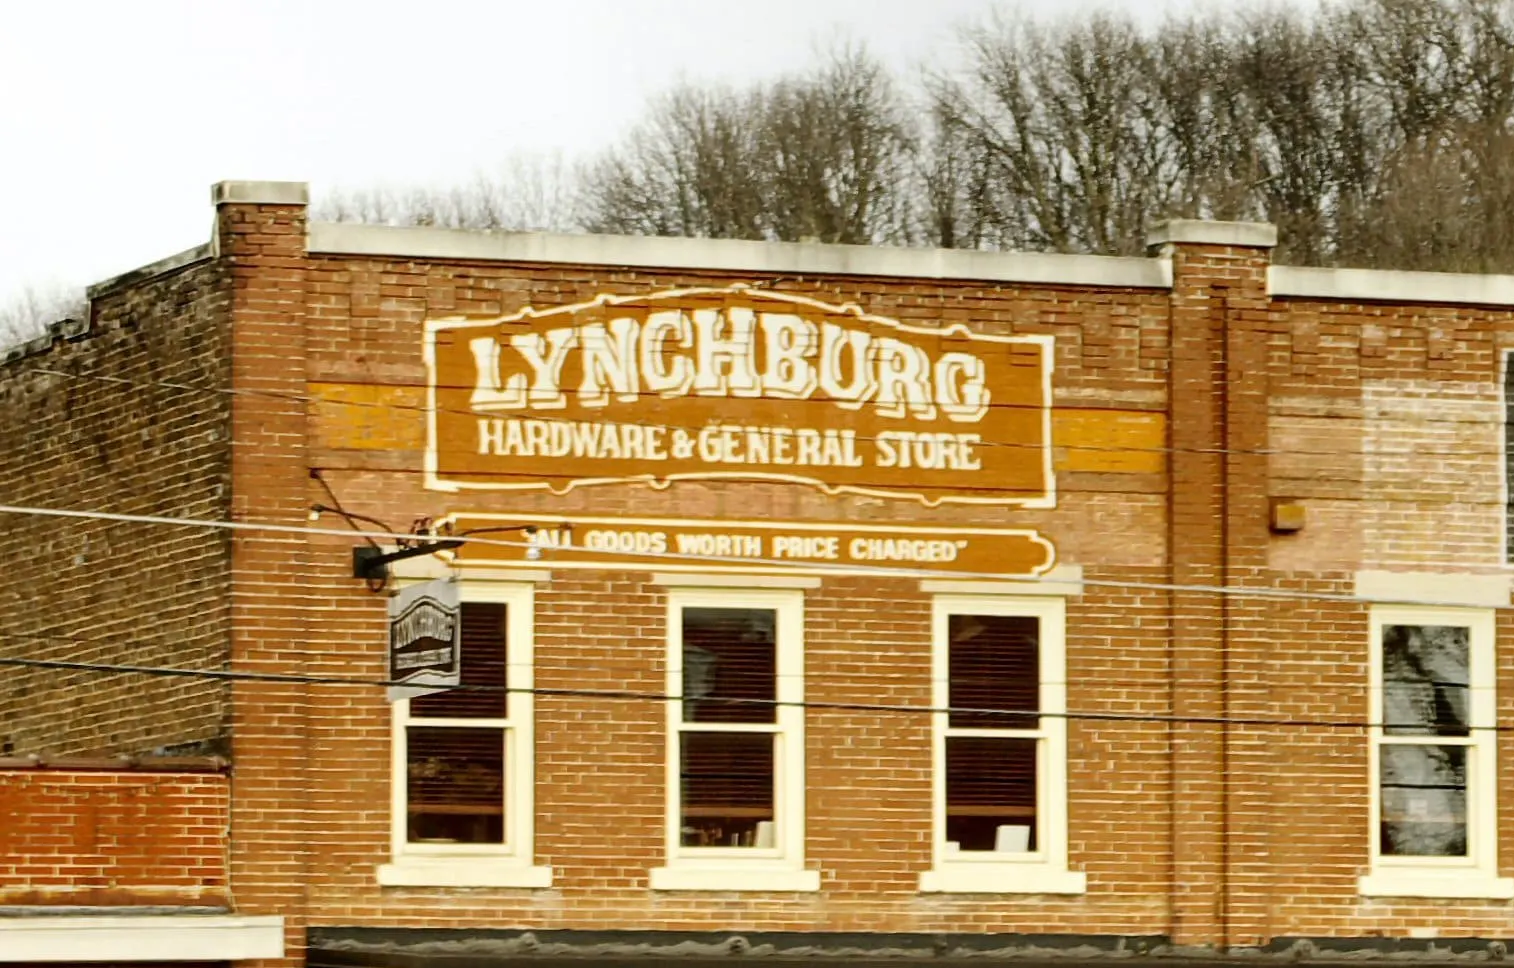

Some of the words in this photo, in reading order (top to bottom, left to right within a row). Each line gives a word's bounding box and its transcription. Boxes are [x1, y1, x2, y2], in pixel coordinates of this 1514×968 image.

[469, 307, 991, 422] LYNCHBURG
[477, 419, 668, 460] HARDWARE
[672, 431, 697, 458] &
[699, 424, 862, 467] GENERAL
[875, 430, 982, 471] STORE
[584, 530, 667, 553] GOODS
[675, 533, 761, 556] WORTH
[772, 536, 839, 558] PRICE
